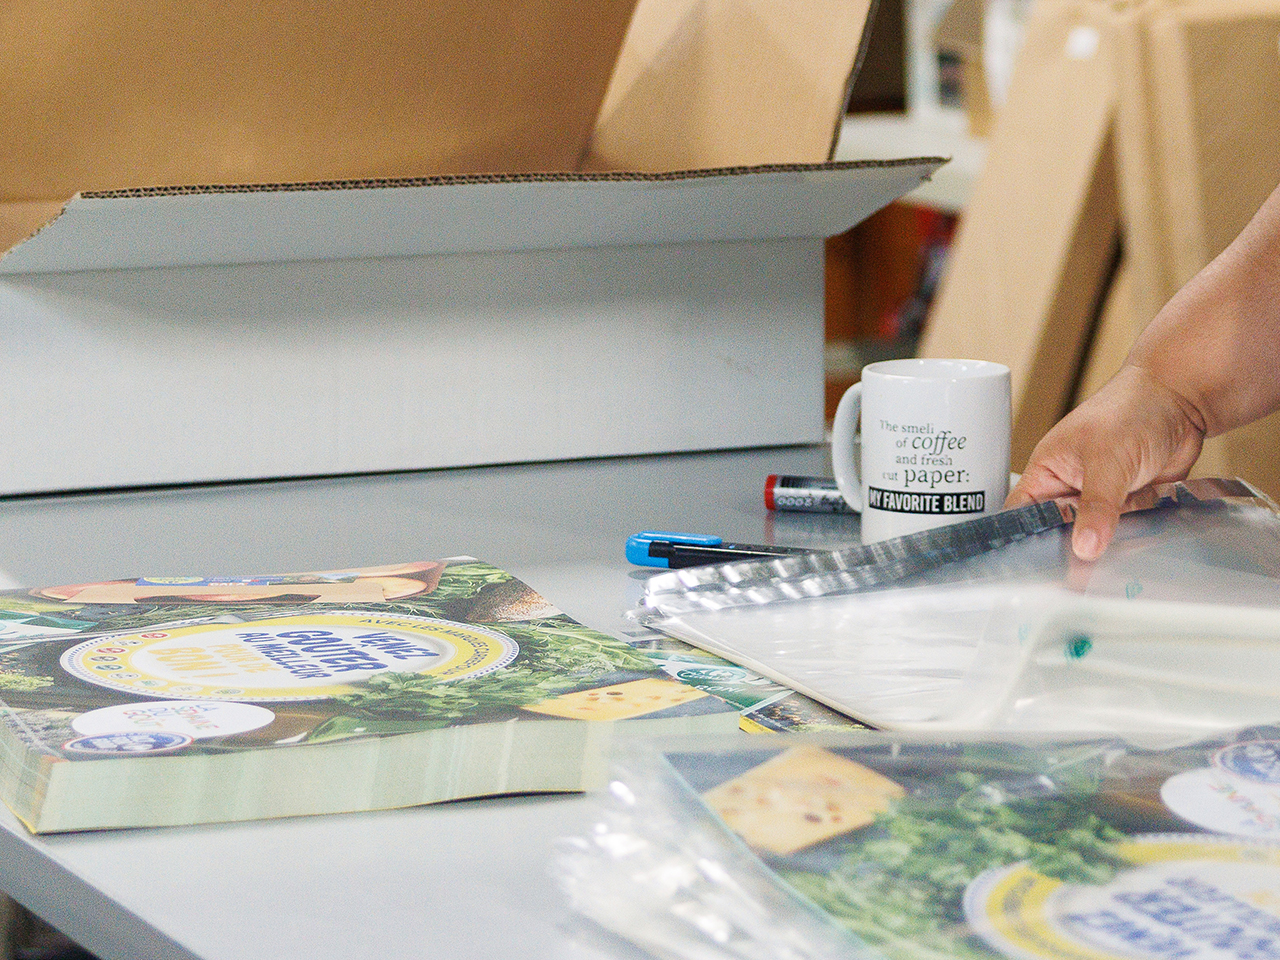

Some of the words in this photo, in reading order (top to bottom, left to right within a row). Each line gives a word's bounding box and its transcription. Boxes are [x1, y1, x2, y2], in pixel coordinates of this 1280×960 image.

[880, 420, 898, 432] The
[896, 437, 908, 447] of
[912, 430, 967, 455] coffee
[896, 454, 917, 465] and
[921, 454, 952, 465] fresh
[904, 468, 970, 488] paper:
[870, 489, 881, 507] MY
[883, 492, 940, 511] FAVORITE
[944, 494, 983, 511] BLEND
[235, 632, 275, 643] AU
[352, 632, 441, 659] VENEZ
[252, 643, 333, 679] MEILLEUR
